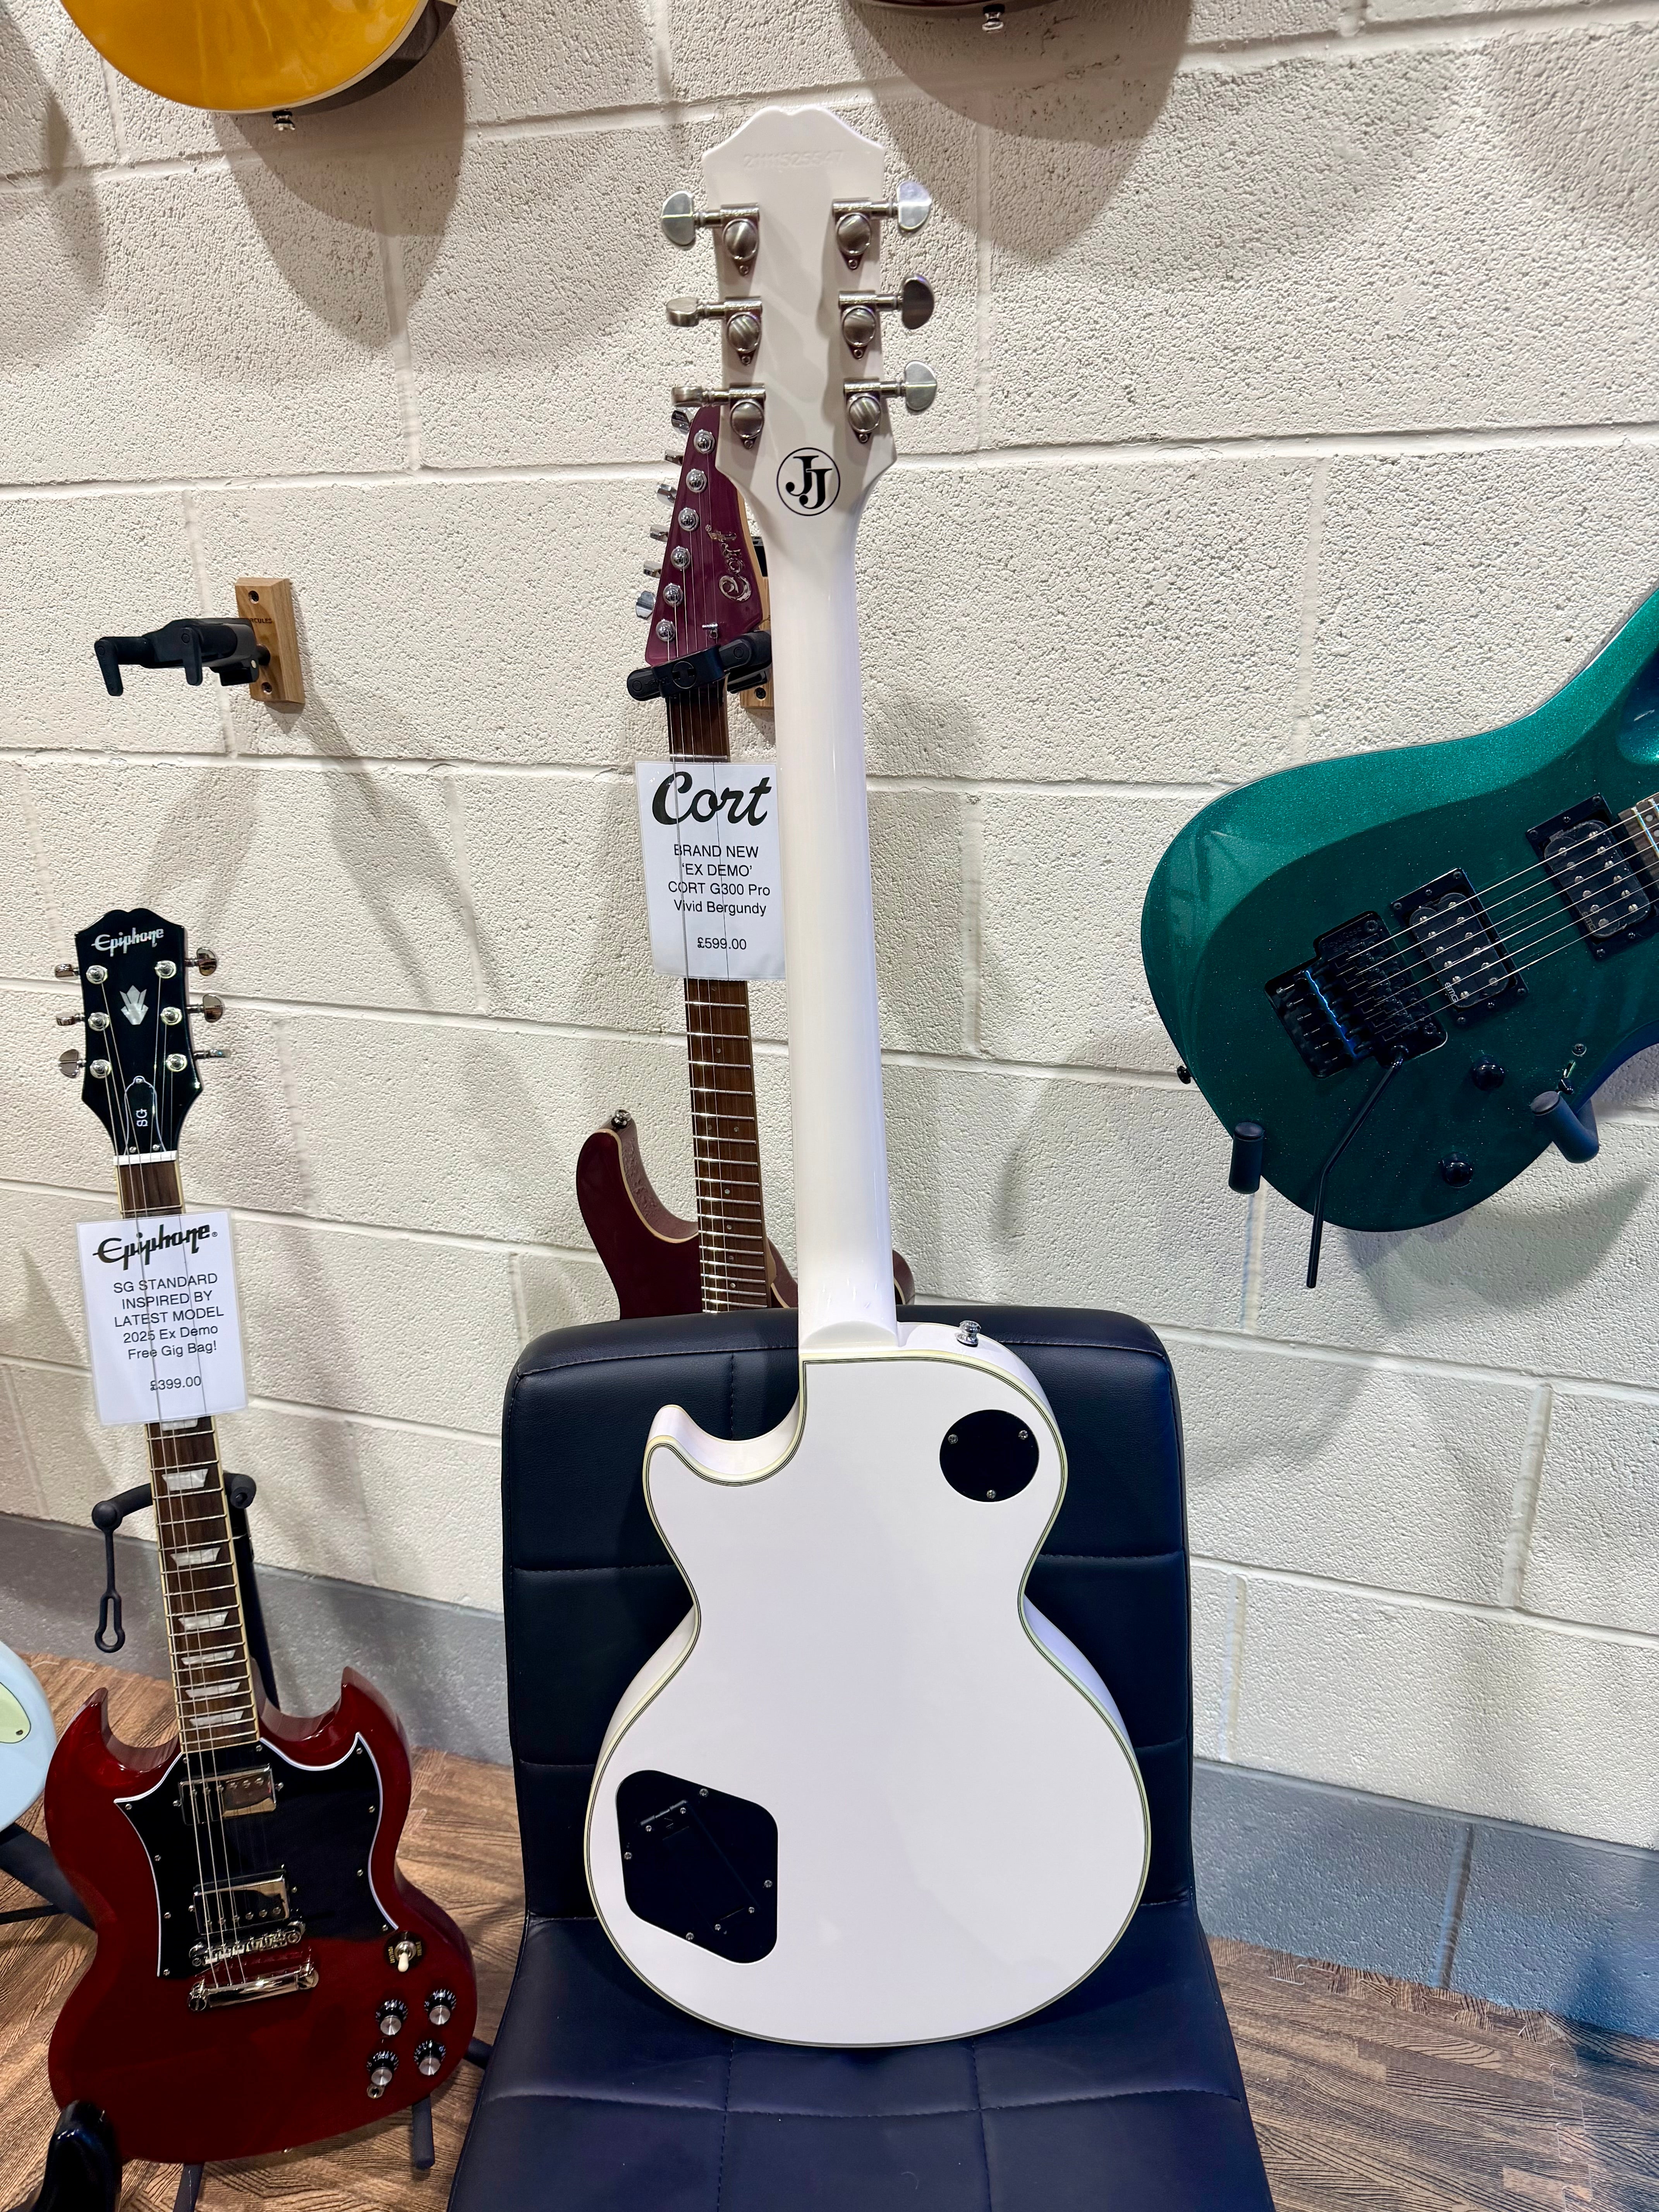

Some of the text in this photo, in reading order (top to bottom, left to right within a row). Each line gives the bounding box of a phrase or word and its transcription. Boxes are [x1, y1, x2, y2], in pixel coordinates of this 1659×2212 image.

[785, 455, 833, 509] JJ
[652, 771, 772, 826] Cort
[674, 844, 759, 858] BRAND NEW
[668, 881, 770, 896] CORT G300 Pro
[674, 900, 767, 916] Vivid Bergundy
[91, 927, 164, 957] Epiphone
[697, 938, 747, 950] £599.00
[136, 1109, 148, 1127] SG
[93, 1224, 210, 1270] Epiphone
[113, 1273, 218, 1293] SG STANDARD
[122, 1290, 212, 1309] INSPIRED BY
[115, 1306, 224, 1327] LATEST MODEL
[123, 1326, 218, 1343] 2025 Ex Demo
[128, 1341, 217, 1359] Free Gig Bag!
[150, 1376, 201, 1391] £399.00
